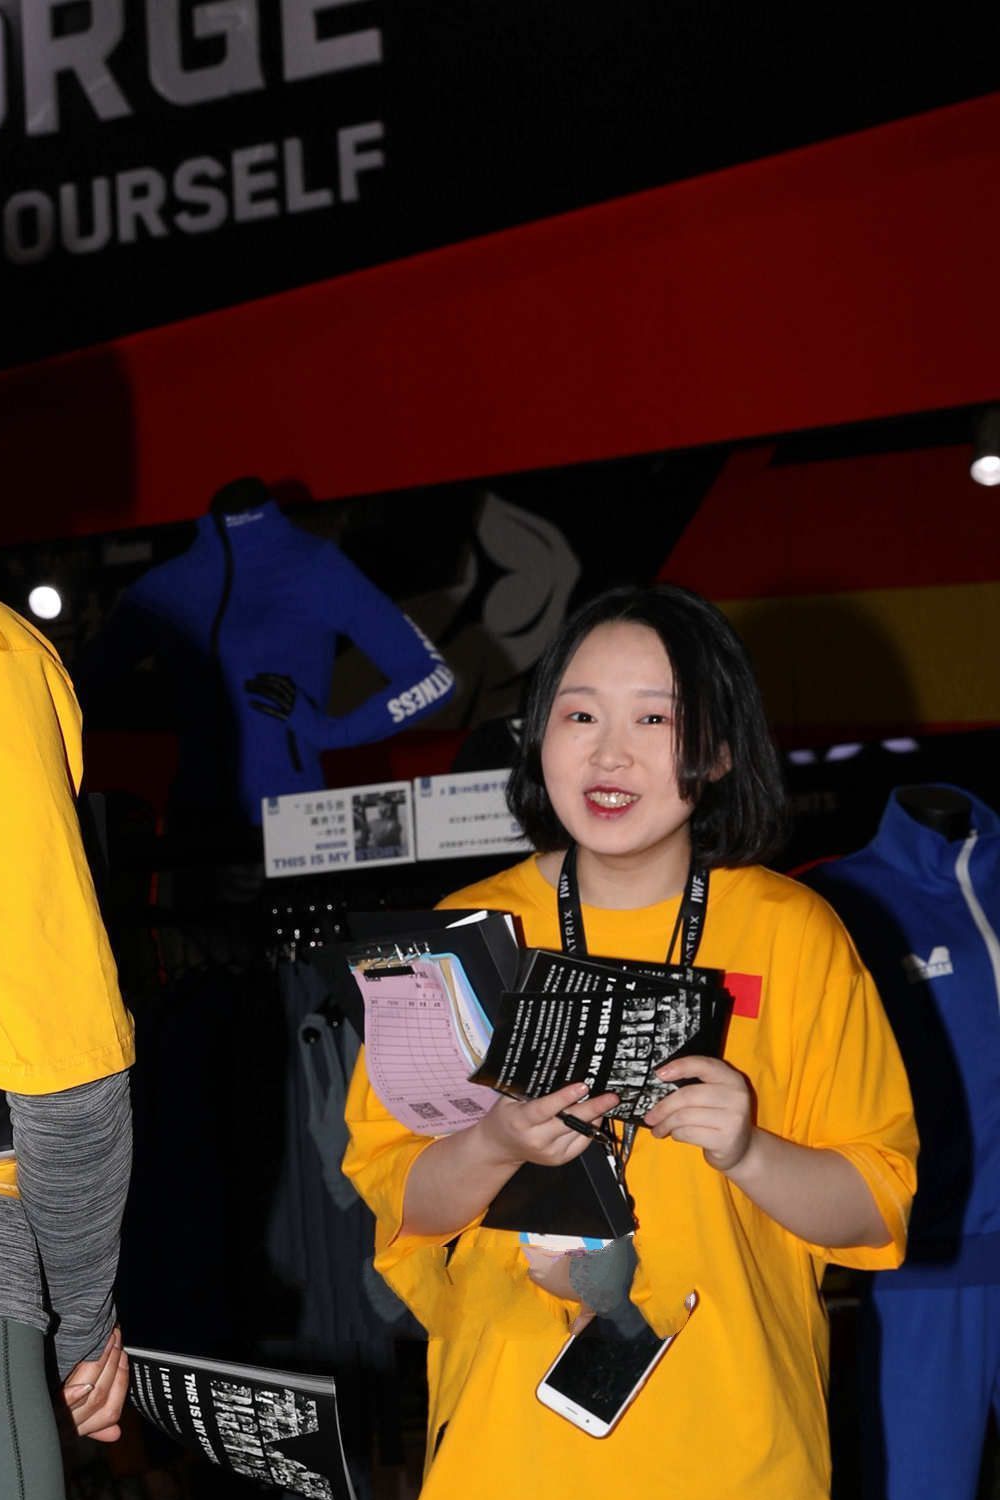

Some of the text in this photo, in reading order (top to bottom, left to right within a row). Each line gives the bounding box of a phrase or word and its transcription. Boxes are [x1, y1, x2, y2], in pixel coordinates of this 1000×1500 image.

[273, 855, 306, 870] THIS
[311, 854, 326, 866] IS
[328, 852, 350, 863] MY
[564, 910, 577, 953] ATRIX
[685, 875, 704, 965] ATRIX IWF
[598, 997, 613, 1035] THIS
[594, 1037, 608, 1052] IS
[587, 1054, 603, 1077] MY
[184, 1373, 200, 1405] THIS
[190, 1404, 203, 1419] IS
[192, 1418, 208, 1437] MY
